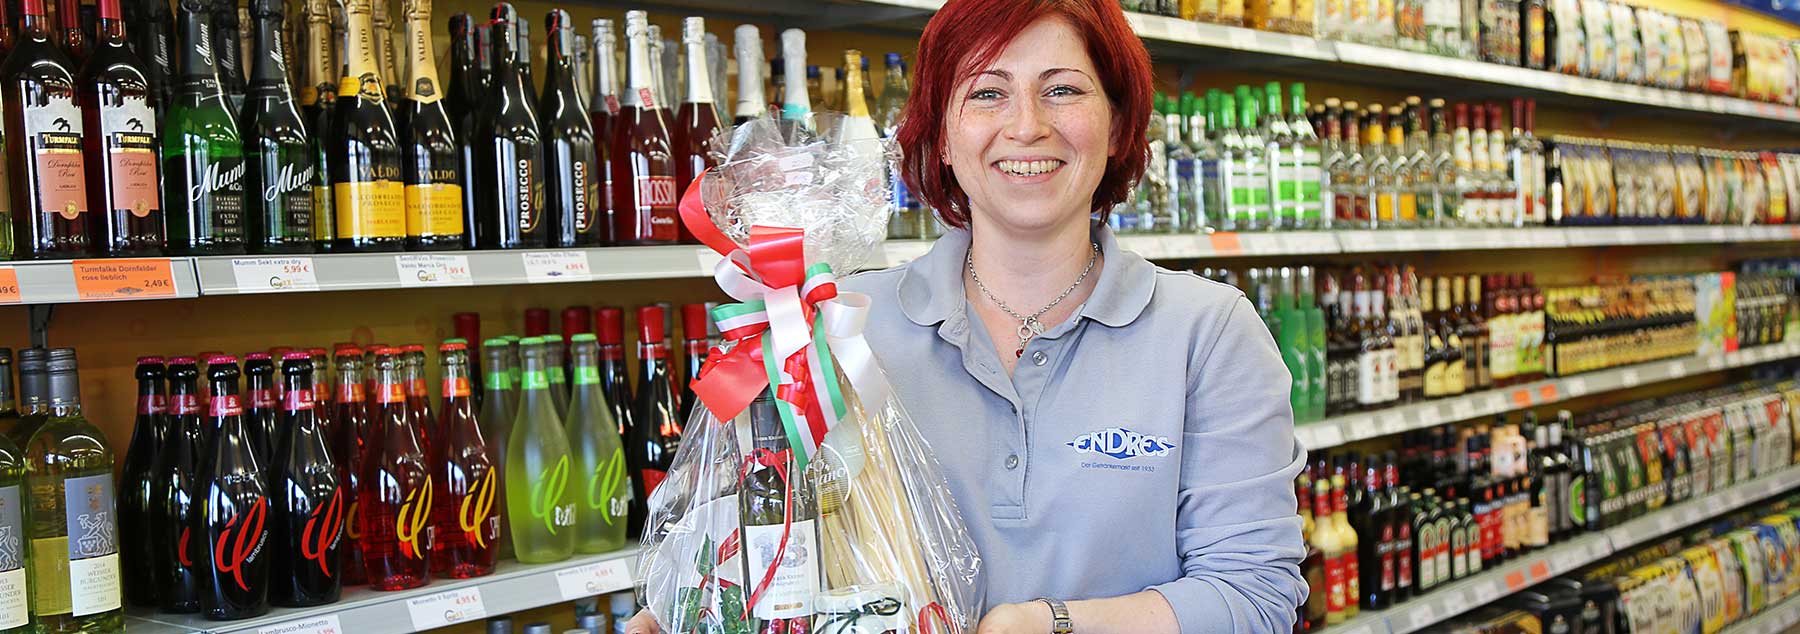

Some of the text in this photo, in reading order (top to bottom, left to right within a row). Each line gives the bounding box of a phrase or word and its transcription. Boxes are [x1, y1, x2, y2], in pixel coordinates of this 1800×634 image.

[196, 23, 212, 66] Mumm
[271, 30, 286, 72] Mumm
[361, 28, 370, 62] VALDO
[418, 30, 427, 62] VALDO
[360, 166, 400, 178] VALDO
[418, 169, 456, 180] VALDO
[519, 159, 530, 229] PROSECCO
[575, 161, 587, 229] PROSECCO
[80, 263, 157, 274] Turmfalke Dornfelder
[100, 273, 128, 282] lieblich
[144, 279, 170, 289] 2,49 €
[1073, 427, 1170, 457] ENDRES
[245, 529, 269, 564] lambrusco
